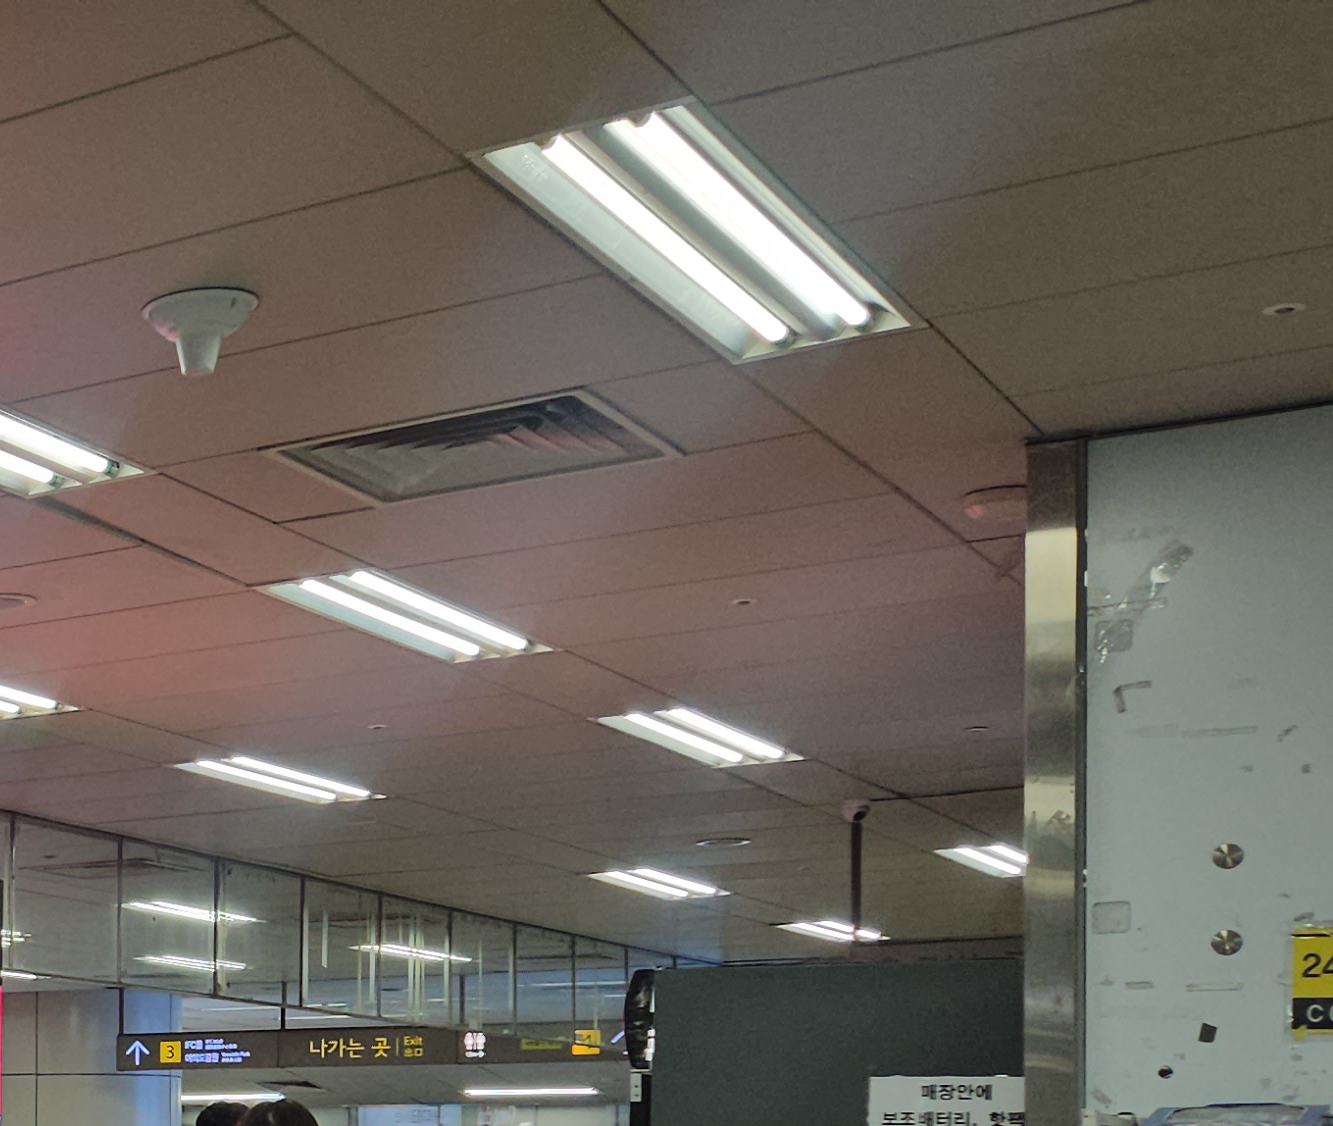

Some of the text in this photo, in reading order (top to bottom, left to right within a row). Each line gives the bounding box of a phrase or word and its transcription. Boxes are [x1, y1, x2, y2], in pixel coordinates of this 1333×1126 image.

[309, 1037, 391, 1058] 나가는 곳
[403, 1035, 423, 1046] Exit
[167, 1045, 175, 1059] 3
[921, 1084, 993, 1101] 매장안에
